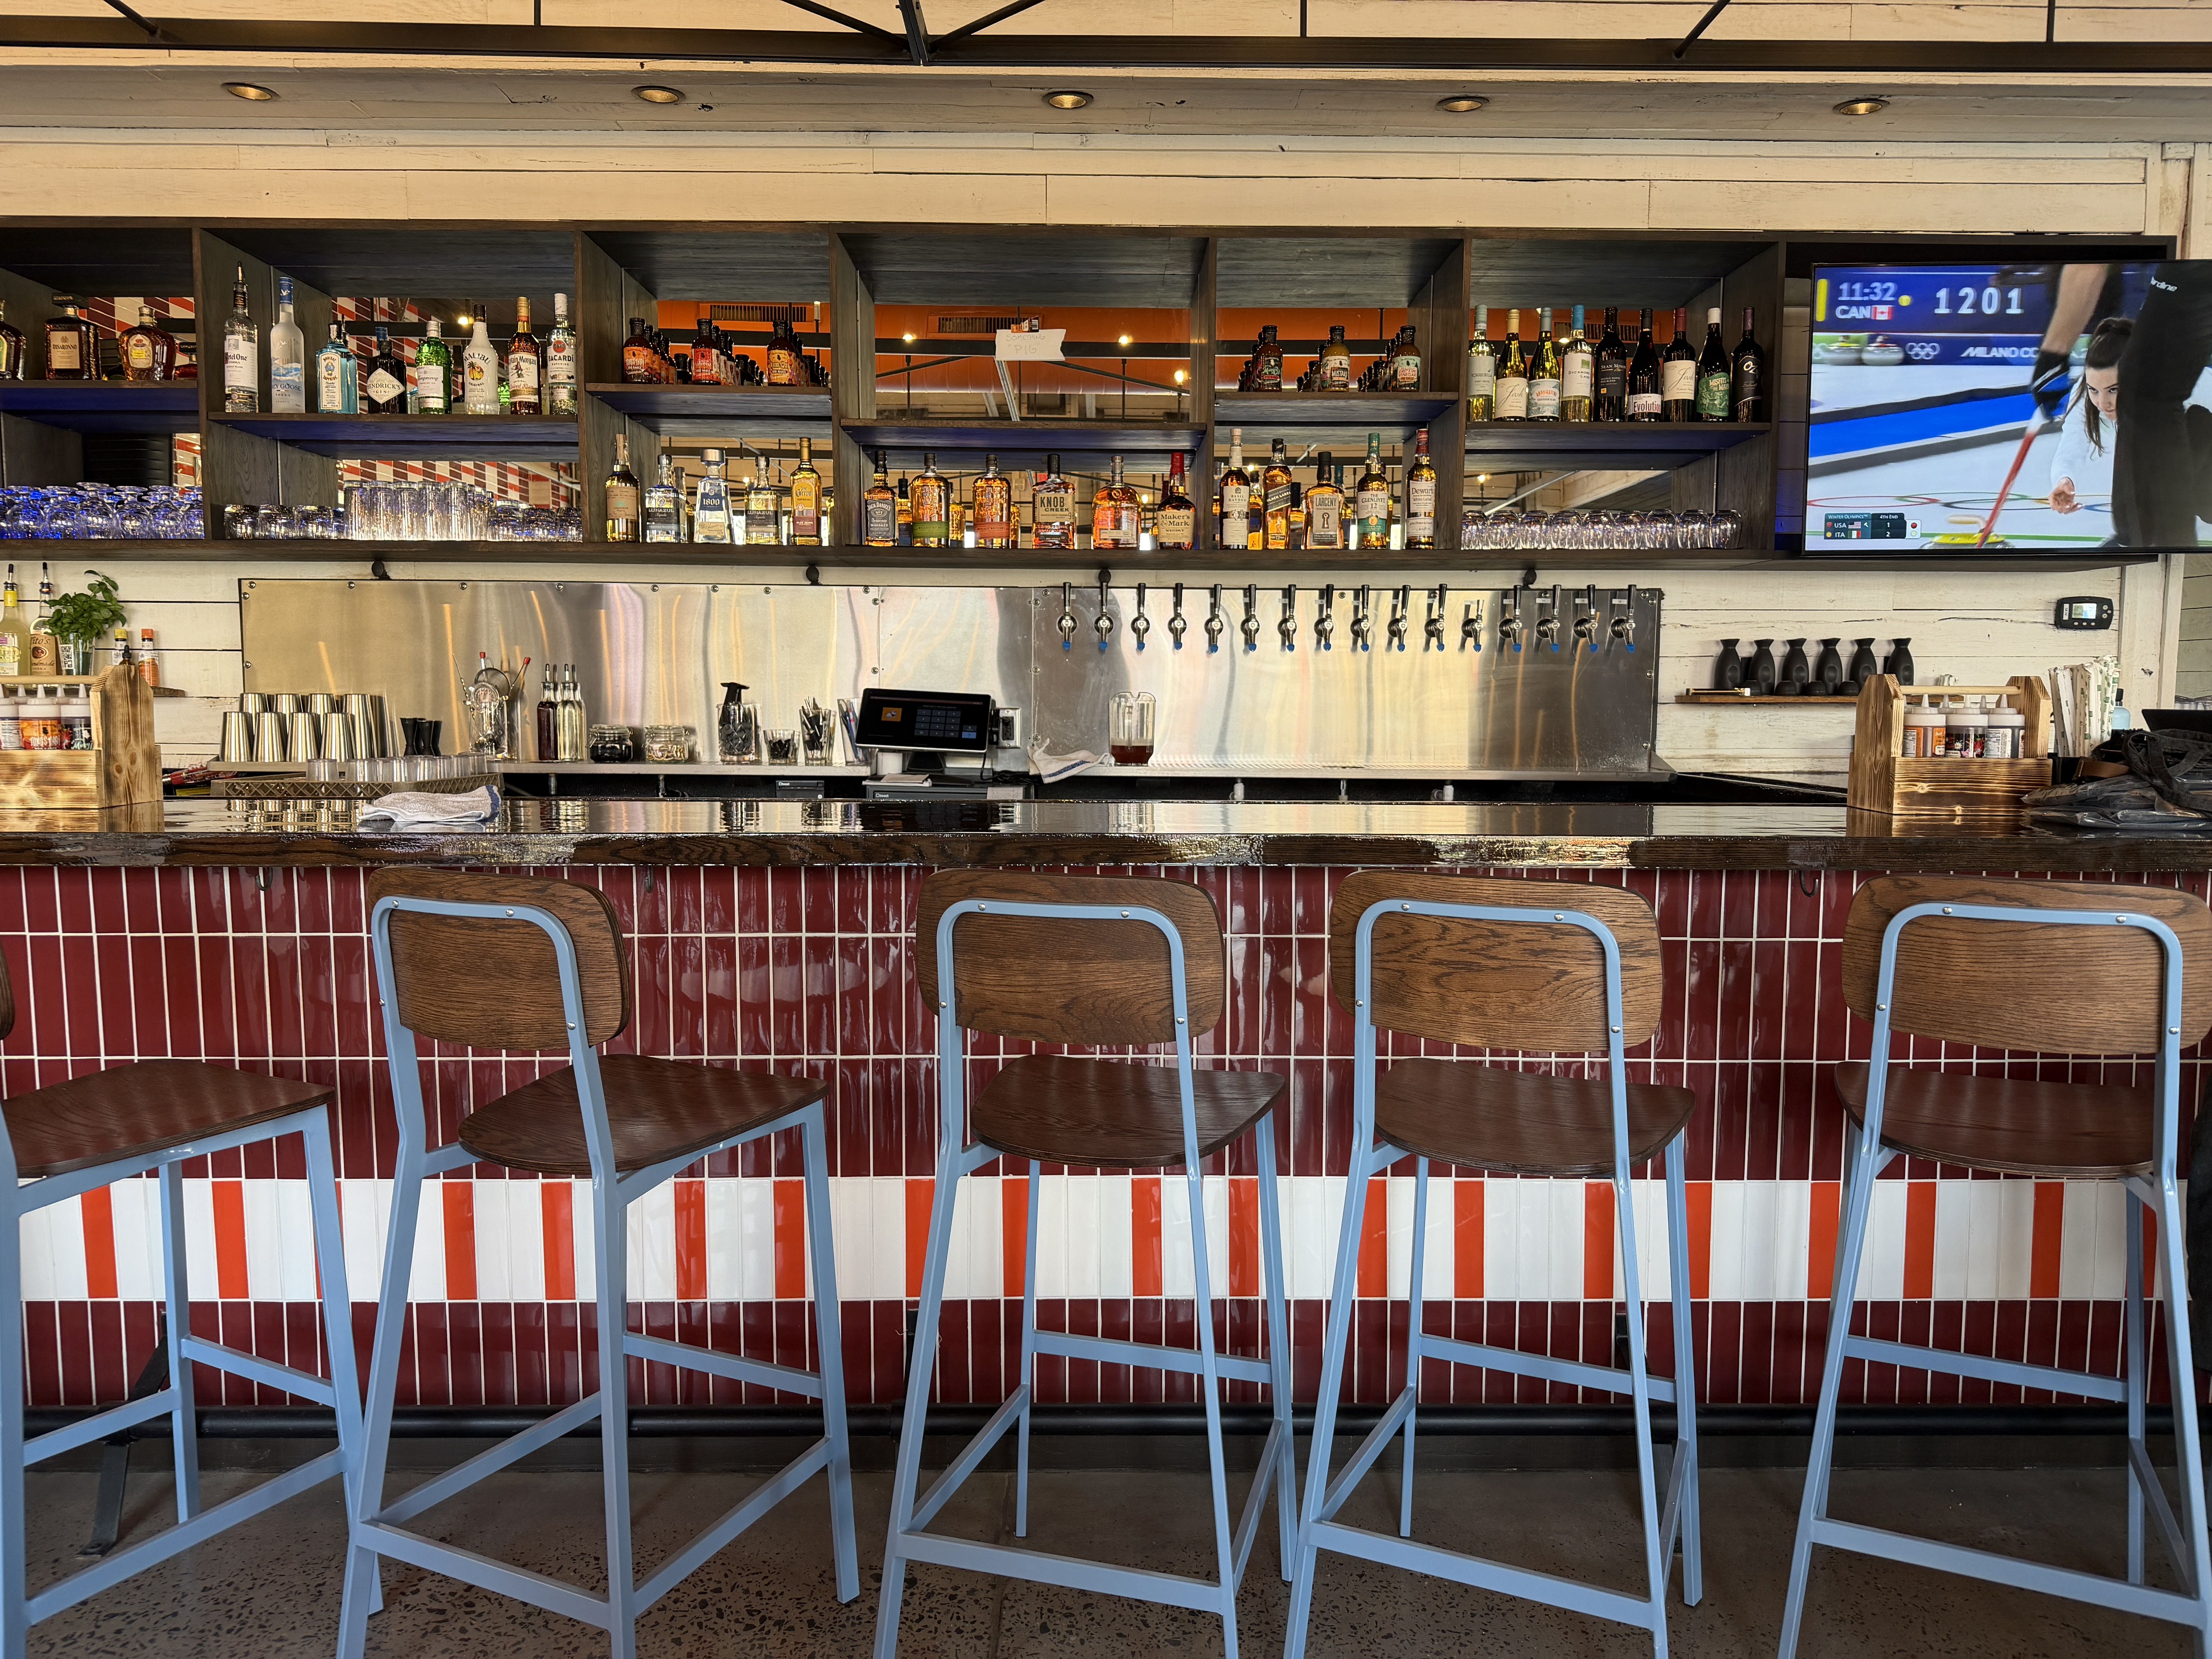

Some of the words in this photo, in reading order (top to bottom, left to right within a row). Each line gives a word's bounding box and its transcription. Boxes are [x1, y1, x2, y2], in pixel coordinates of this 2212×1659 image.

[1838, 282, 1897, 301] 11:32
[1835, 305, 1871, 319] CAN
[464, 352, 491, 364] MALIBU
[1960, 347, 2019, 357] MILANO
[519, 356, 536, 365] Morgan
[1668, 367, 1695, 392] Josh
[280, 383, 301, 391] GOOSE
[1498, 384, 1525, 409] Josh
[1633, 400, 1661, 412] Evolution
[1040, 496, 1065, 508] KNOB
[1316, 497, 1337, 507] LARCENY
